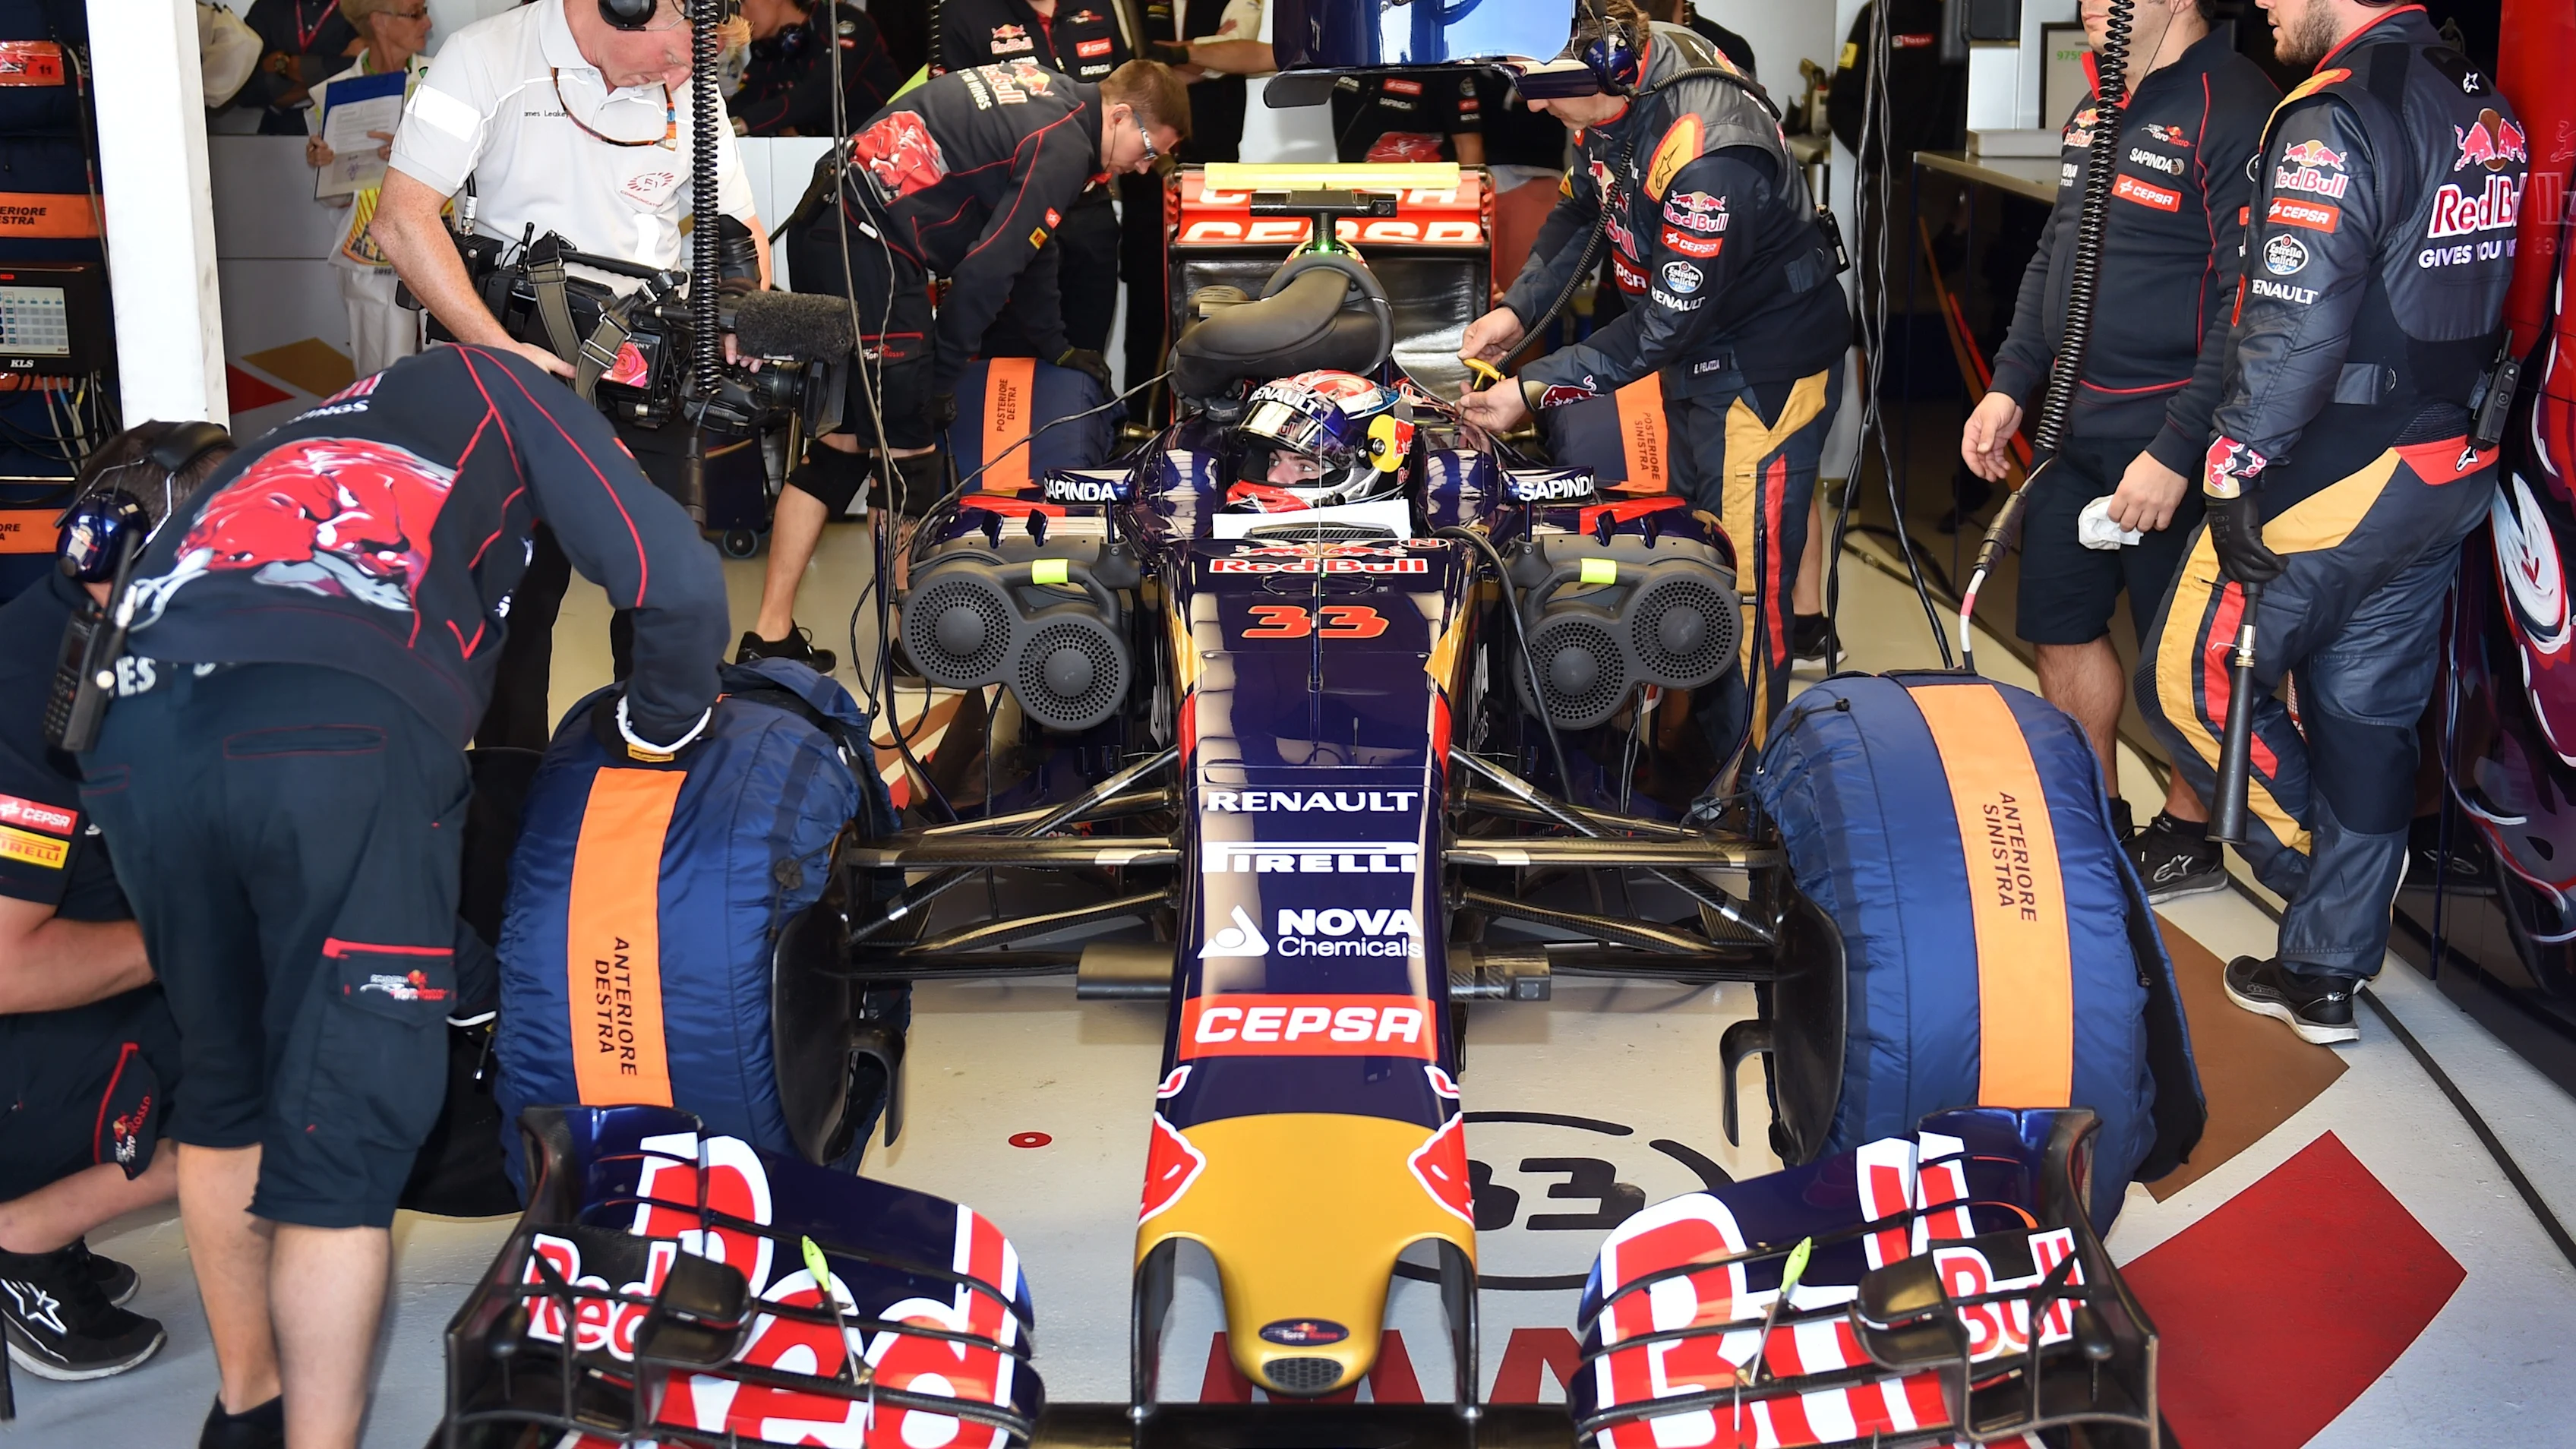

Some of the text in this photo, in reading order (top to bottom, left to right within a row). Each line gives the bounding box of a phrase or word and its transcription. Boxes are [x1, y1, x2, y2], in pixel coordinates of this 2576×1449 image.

[2129, 148, 2174, 174] SAPINDA
[2132, 186, 2174, 206] CEPSA
[2301, 168, 2349, 200] Bull
[1663, 200, 1730, 232] Red Bull
[2281, 207, 2330, 224] CEPSA
[2427, 174, 2496, 238] Red
[1679, 239, 1717, 254] CEPSA
[2268, 243, 2302, 259] Estrella
[2418, 245, 2473, 268] GIVES
[1651, 285, 1706, 311] RENAULT
[996, 378, 1008, 432] POSTERIORE
[1007, 387, 1017, 421] DESTRA
[1634, 420, 1649, 471] SINISTRA
[1643, 412, 1661, 480] POSTERIORE
[1043, 477, 1118, 501] SAPINDA
[1519, 474, 1594, 502] SAPINDA
[1209, 558, 1428, 573] Red Bull
[1242, 605, 1390, 639] 33
[1207, 791, 1419, 812] RENAULT
[21, 807, 71, 828] CEPSA
[1201, 841, 1419, 873] PIRELLI
[1983, 803, 2015, 907] SINISTRA
[2000, 791, 2038, 923] ANTERIORE
[1277, 908, 1422, 937] NOVA
[1277, 935, 1423, 958] Chemicals
[595, 959, 615, 1054] DESTRA
[614, 936, 637, 1076] ANTERIORE
[1194, 1006, 1423, 1043] CEPSA
